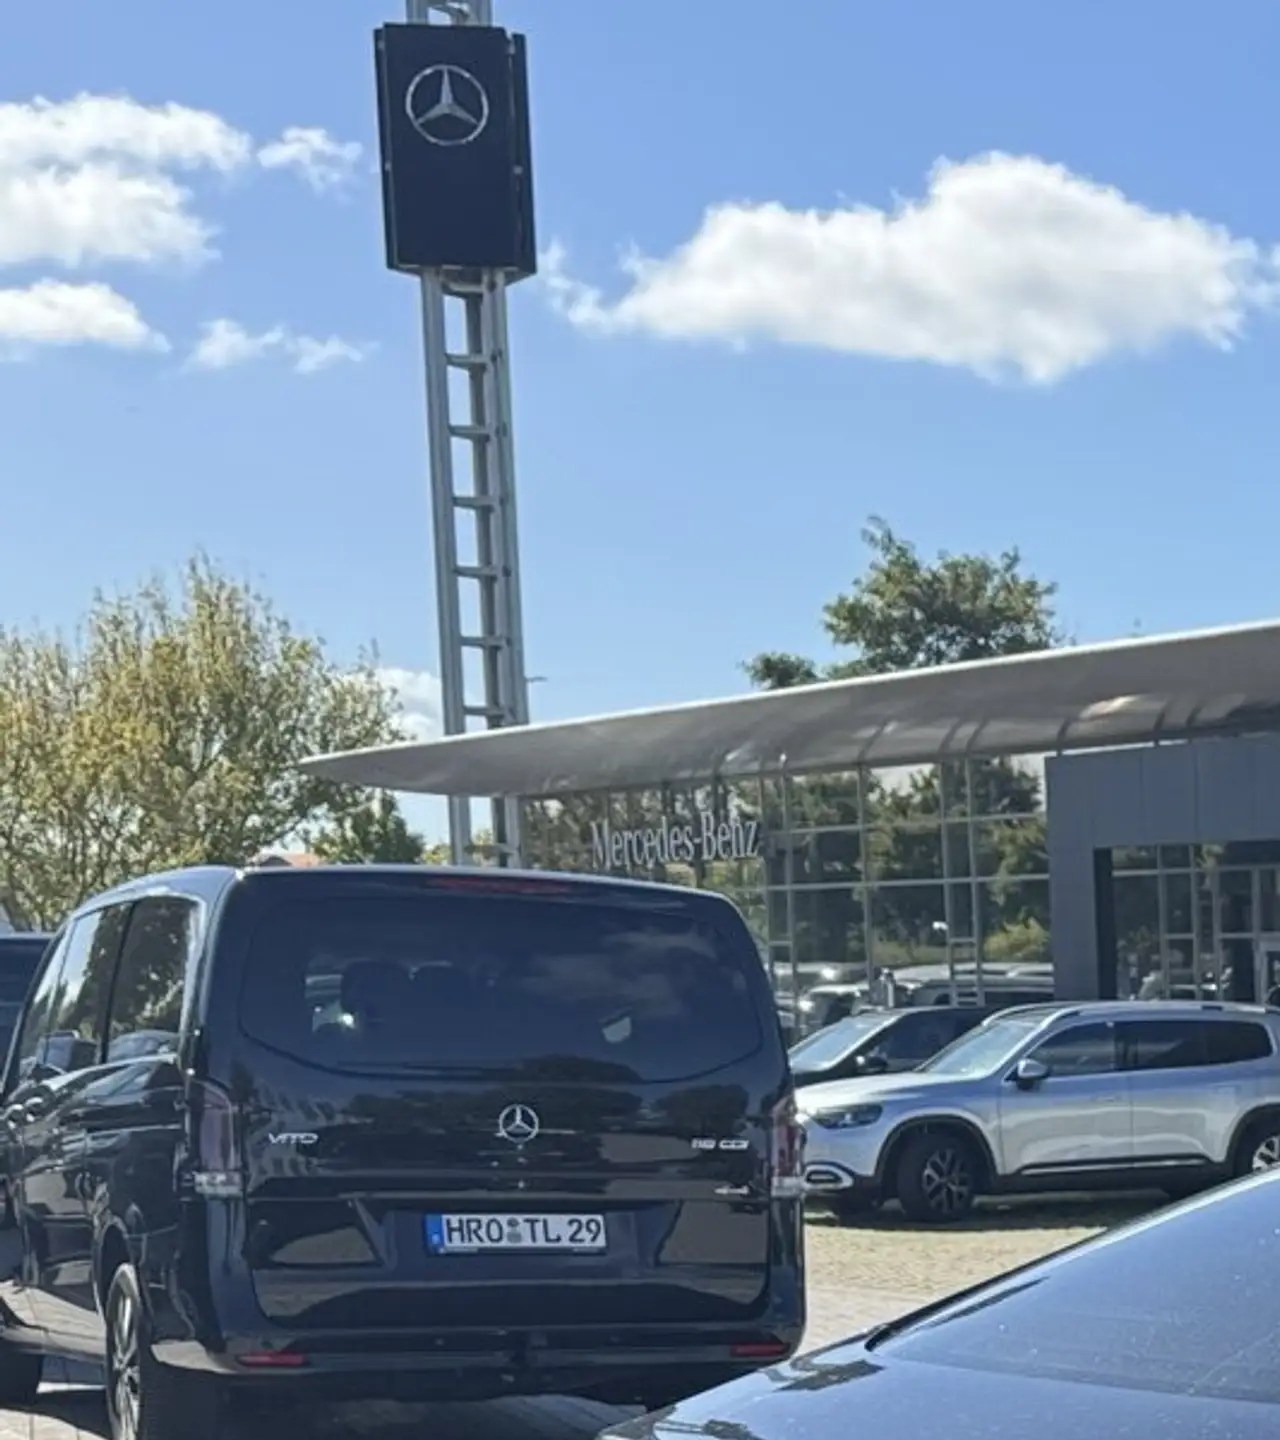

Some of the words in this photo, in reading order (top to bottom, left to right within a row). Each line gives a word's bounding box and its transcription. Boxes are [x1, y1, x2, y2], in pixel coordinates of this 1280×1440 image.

[589, 811, 758, 871] Mercedes-Benz
[446, 1217, 503, 1244] HRO
[523, 1218, 562, 1243] TL
[567, 1218, 602, 1243] 29
